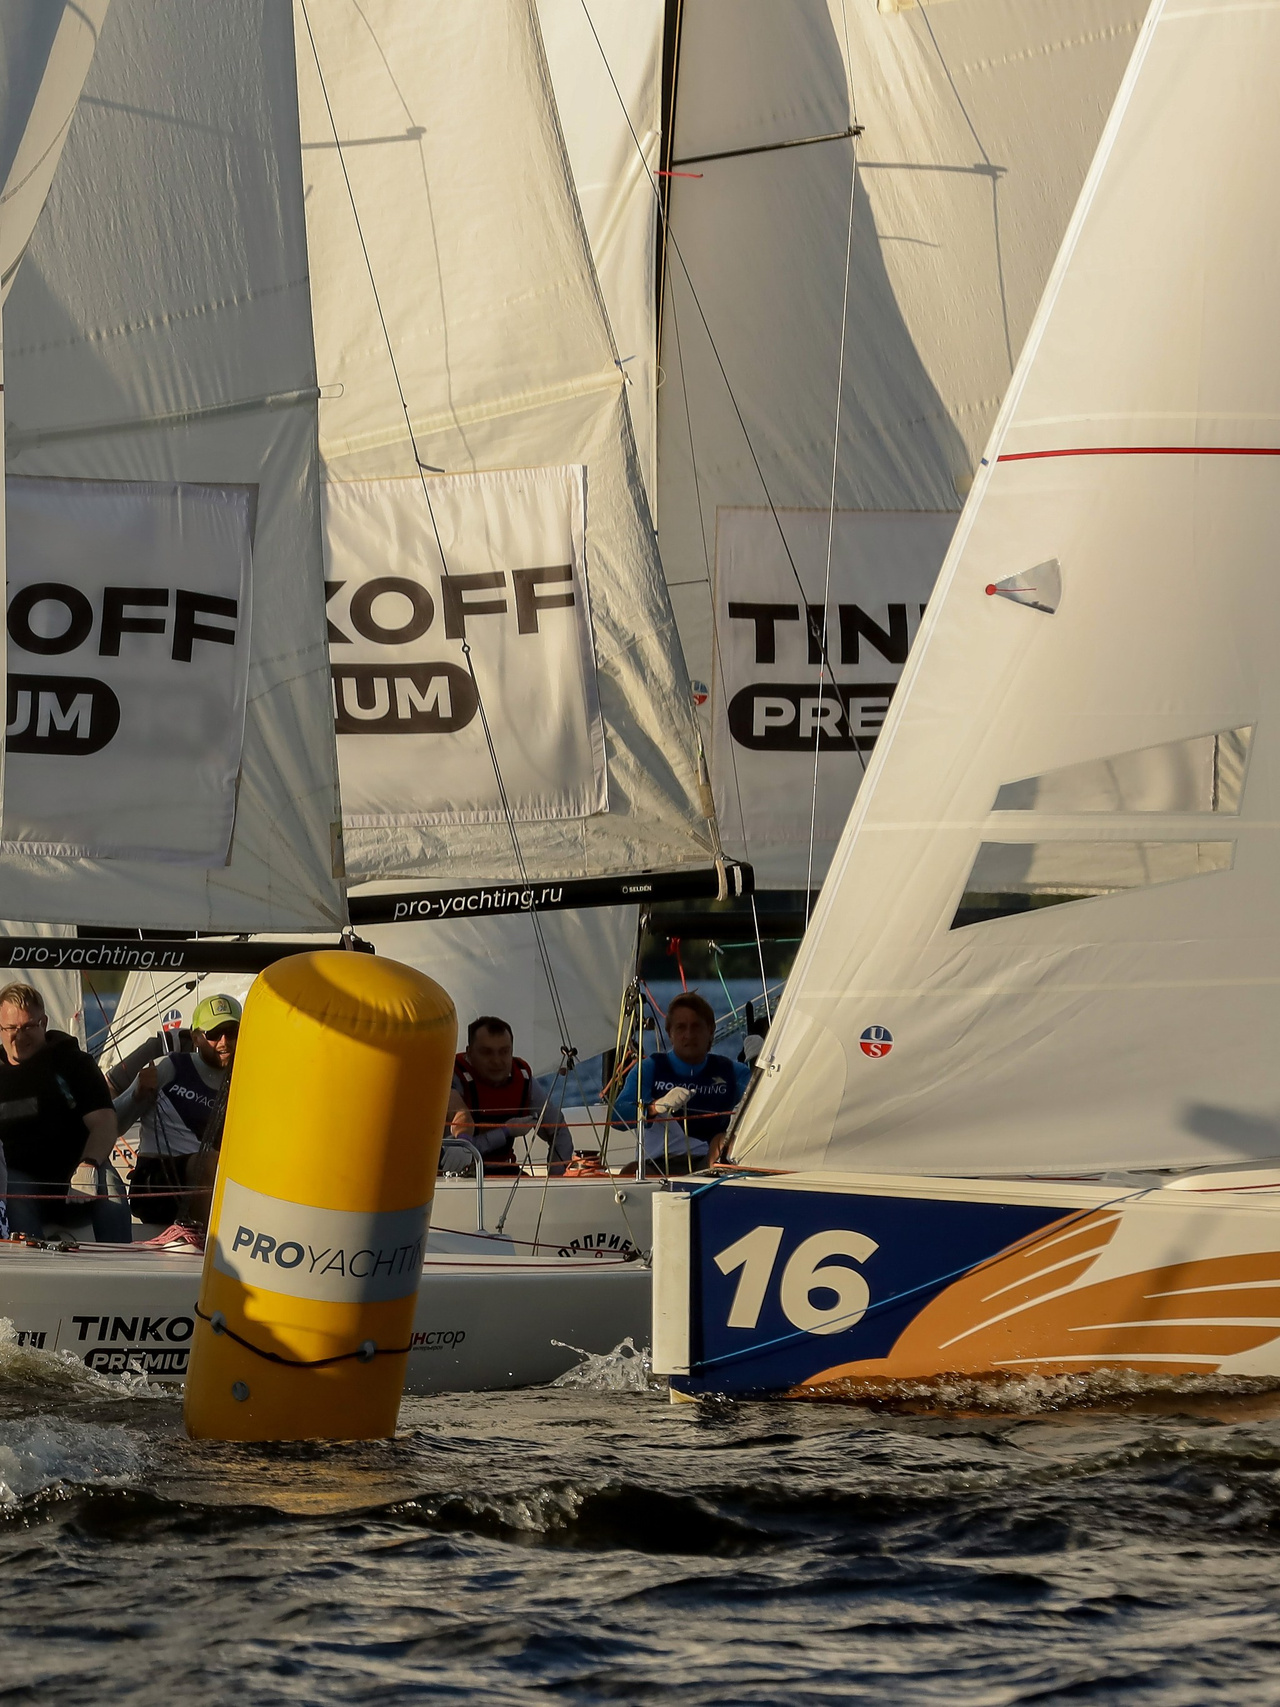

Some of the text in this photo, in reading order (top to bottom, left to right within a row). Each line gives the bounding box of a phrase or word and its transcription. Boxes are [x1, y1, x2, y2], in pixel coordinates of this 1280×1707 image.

[7, 582, 238, 663] OFF
[728, 602, 927, 665] TIN
[394, 887, 563, 920] pro-yachting.ru
[8, 945, 185, 970] pro-yachting.ru
[713, 1225, 881, 1336] 16
[72, 1316, 195, 1342] TINKO
